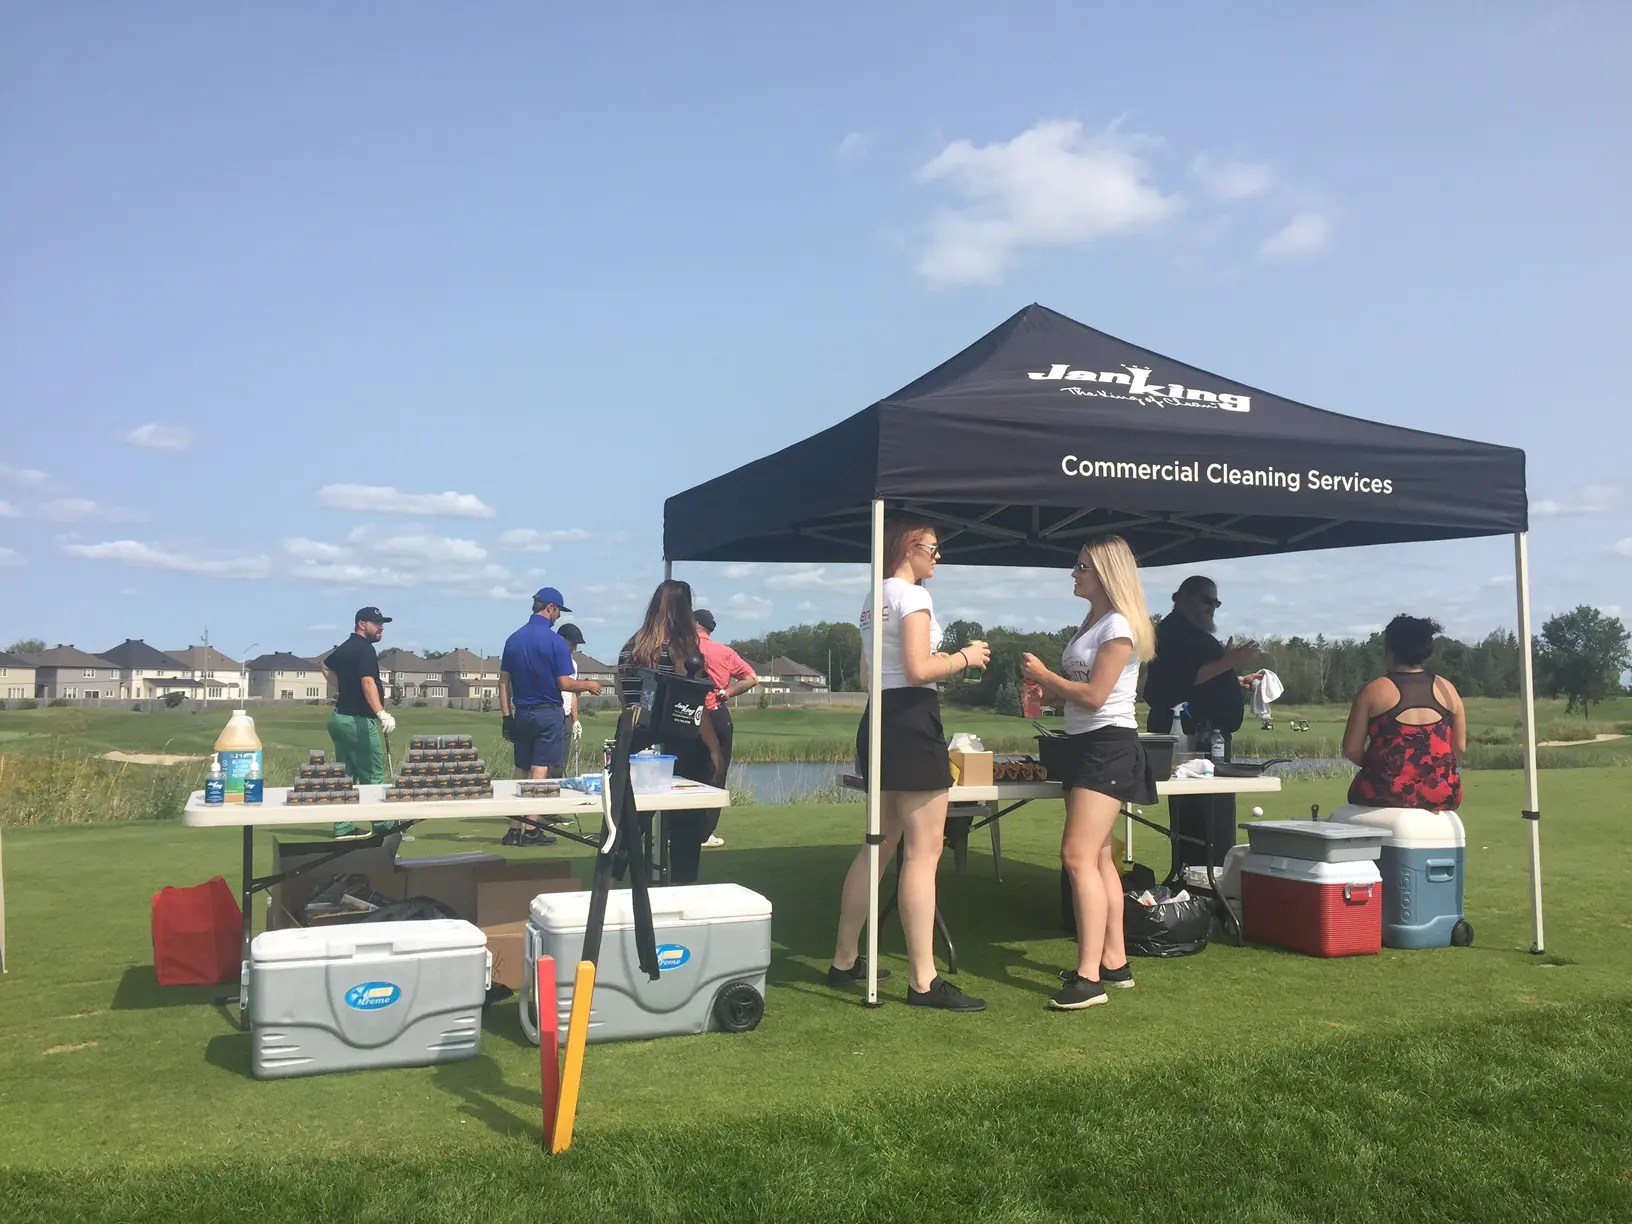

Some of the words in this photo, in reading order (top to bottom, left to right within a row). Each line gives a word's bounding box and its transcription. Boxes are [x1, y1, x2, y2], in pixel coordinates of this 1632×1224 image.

[1060, 454, 1199, 483] Commercial
[1206, 462, 1301, 493] Cleaning
[1306, 469, 1394, 495] Services
